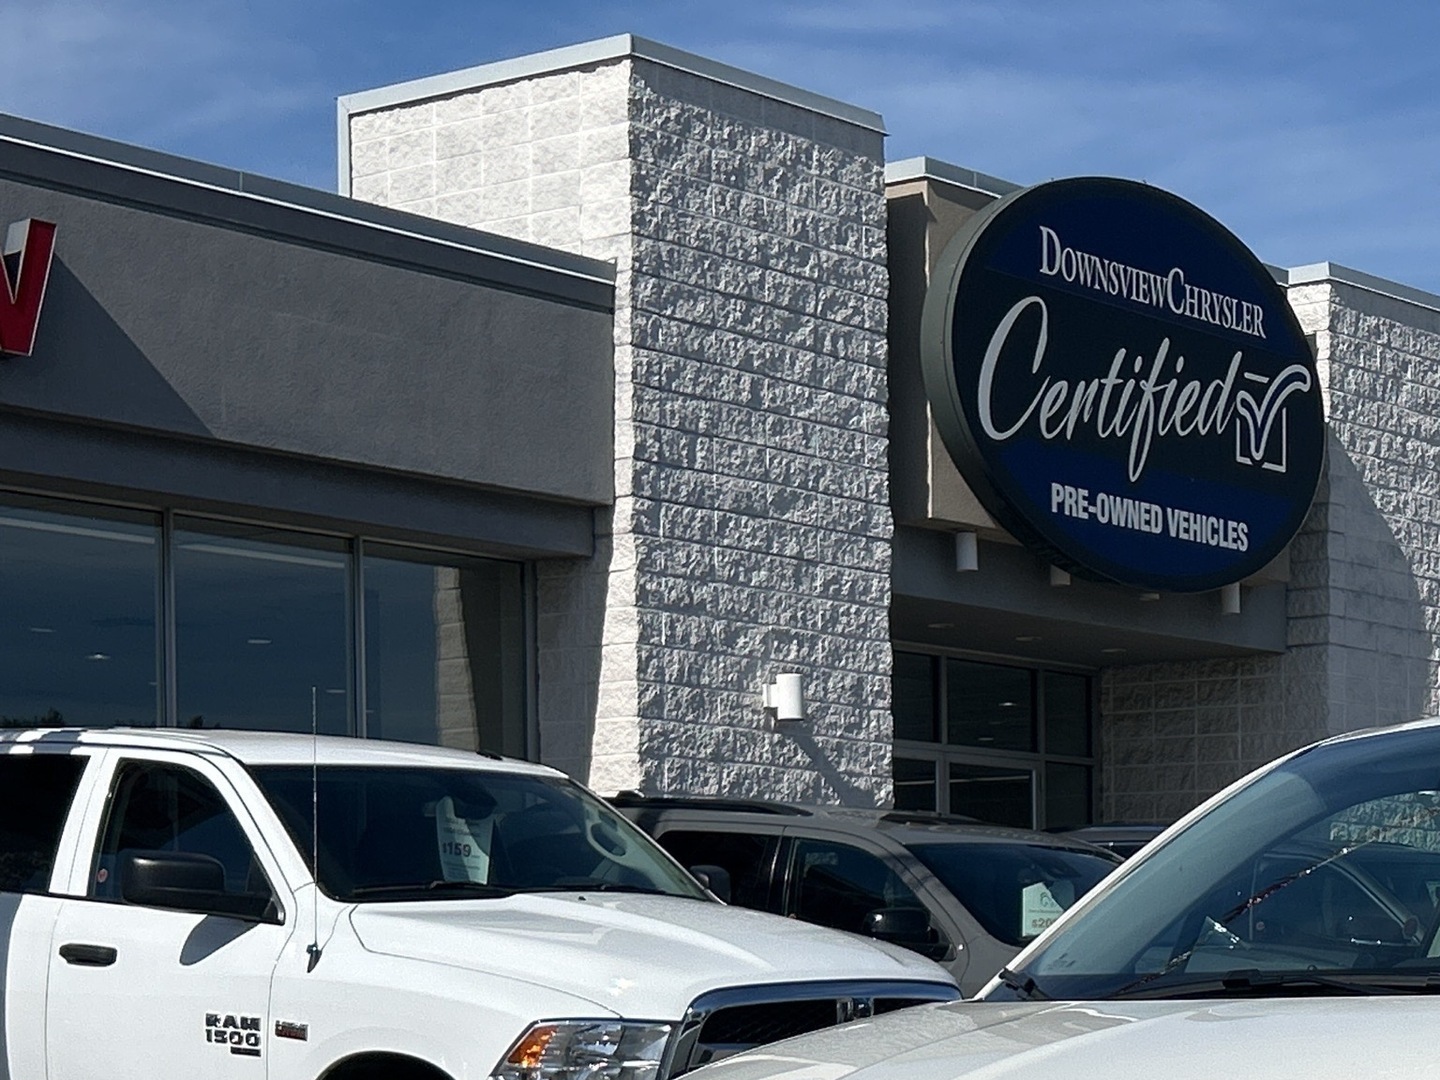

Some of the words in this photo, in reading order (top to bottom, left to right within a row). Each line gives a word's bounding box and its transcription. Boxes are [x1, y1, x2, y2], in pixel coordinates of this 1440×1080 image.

[977, 296, 1242, 482] Certified
[1051, 482, 1163, 535] PRE-OWNED
[1167, 506, 1249, 552] VEHICLES
[205, 1013, 261, 1031] RAM
[205, 1028, 261, 1047] 1500
